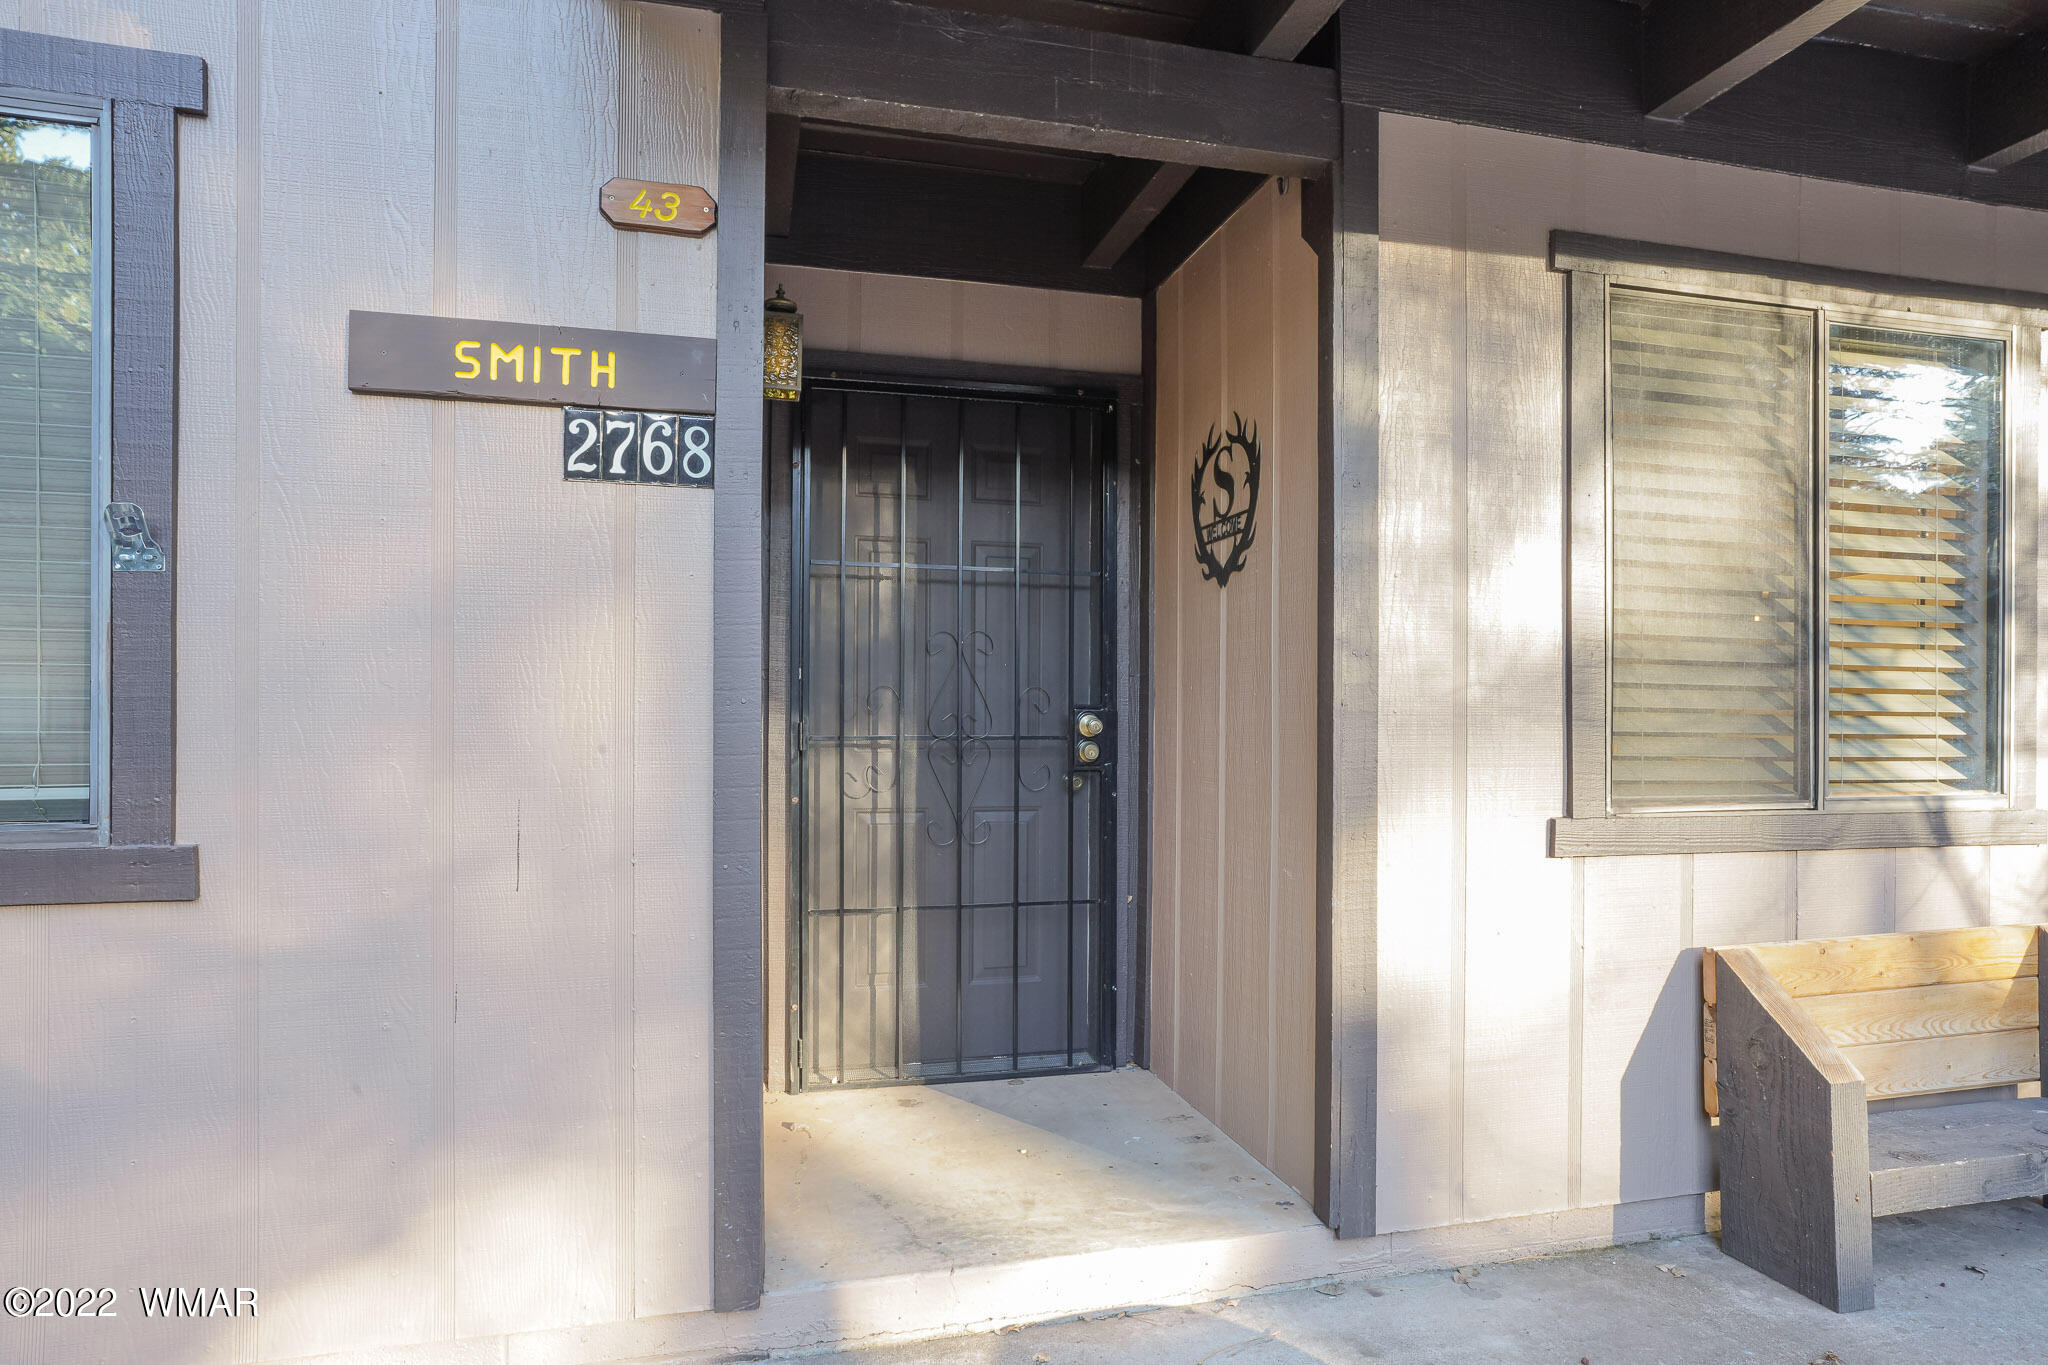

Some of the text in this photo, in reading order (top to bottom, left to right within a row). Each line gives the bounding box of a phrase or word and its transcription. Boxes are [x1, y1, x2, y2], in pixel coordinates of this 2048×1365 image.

[630, 189, 681, 221] 43
[454, 340, 616, 389] SMITH
[567, 419, 711, 478] 2768
[1213, 446, 1235, 518] S
[1206, 515, 1242, 541] WELCOME
